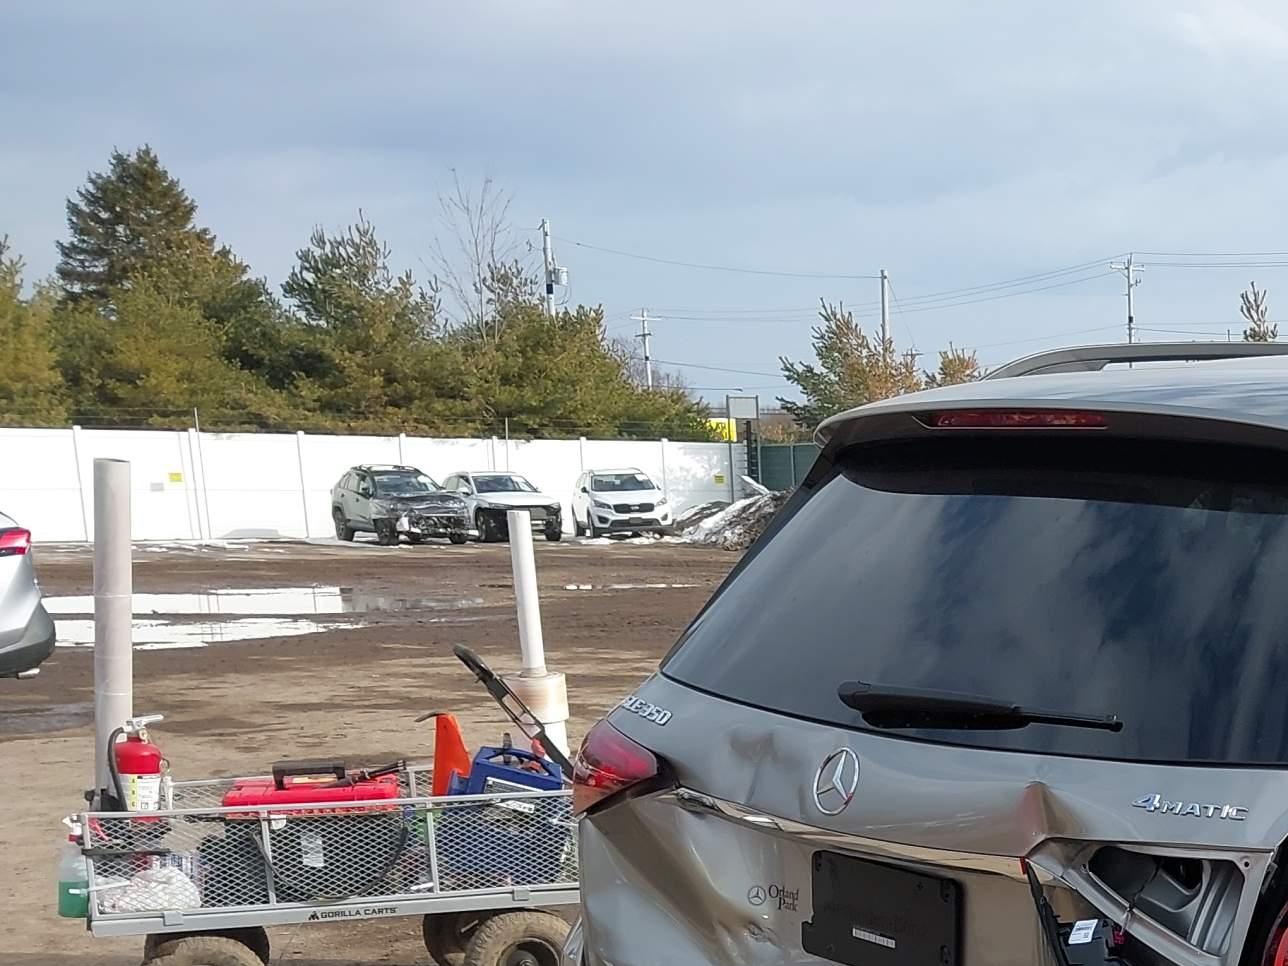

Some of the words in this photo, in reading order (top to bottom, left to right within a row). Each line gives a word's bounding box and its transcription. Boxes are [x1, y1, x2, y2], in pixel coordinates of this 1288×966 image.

[1132, 793, 1249, 821] 4MATIC
[768, 884, 799, 901] Orland
[778, 896, 798, 912] Park
[320, 909, 362, 919] GORILLA
[363, 907, 397, 916] CARTS
